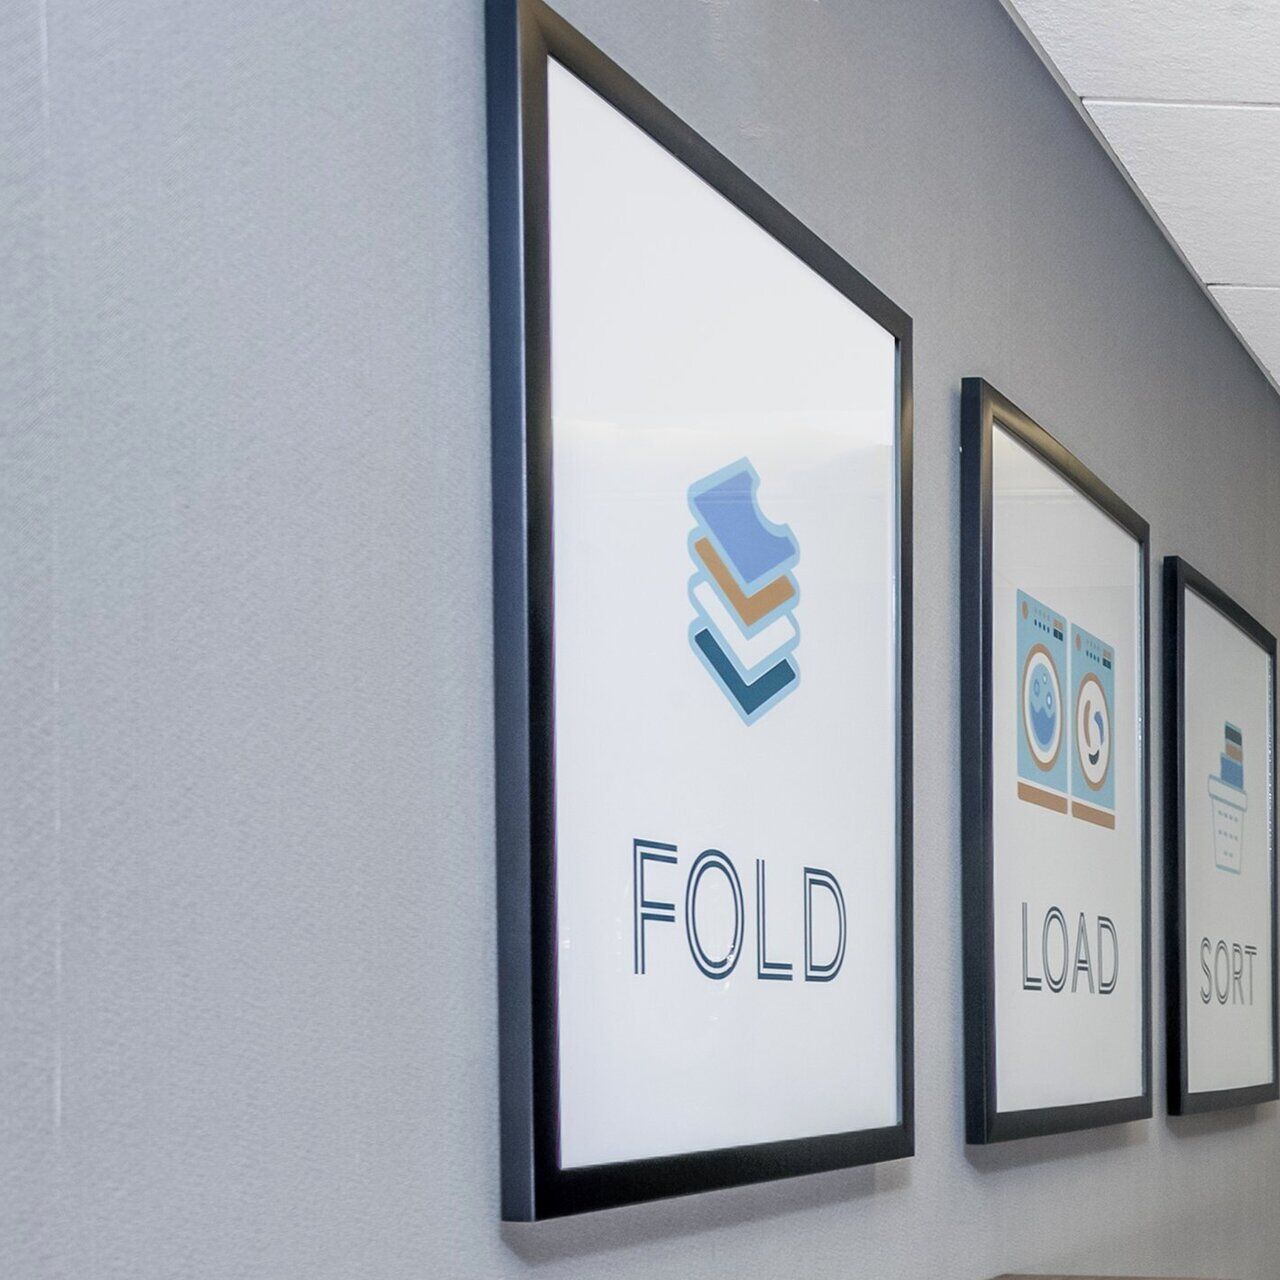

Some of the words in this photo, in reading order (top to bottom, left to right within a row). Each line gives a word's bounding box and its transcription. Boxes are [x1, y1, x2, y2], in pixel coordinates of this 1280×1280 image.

[632, 837, 848, 983] FOLD
[1021, 901, 1119, 995] LOAD
[1200, 936, 1258, 1006] SORT
